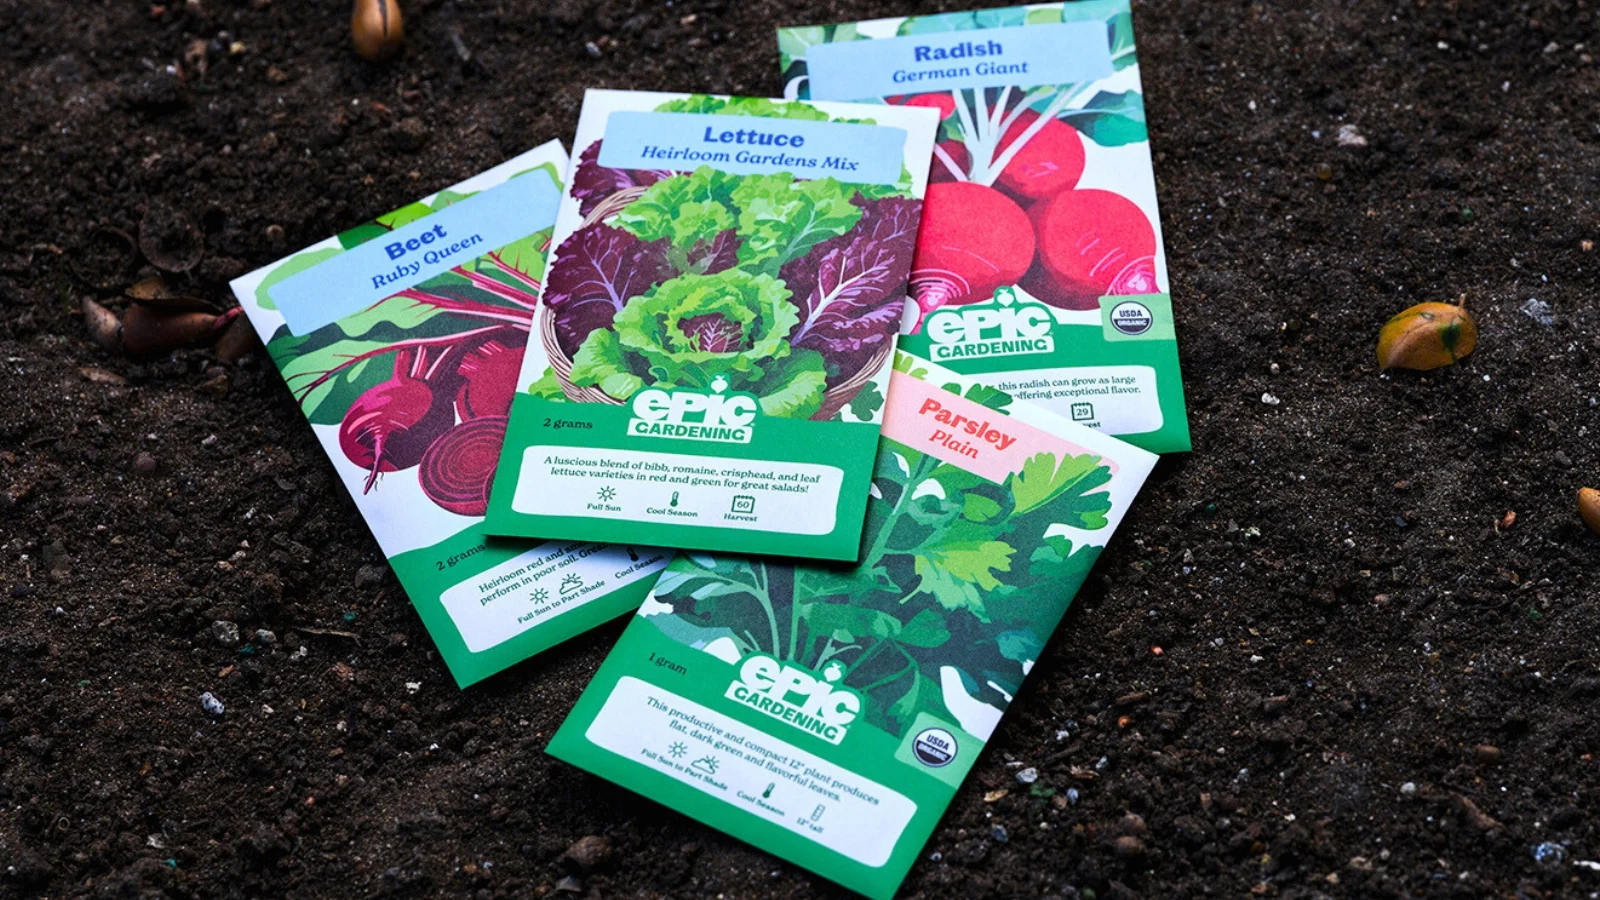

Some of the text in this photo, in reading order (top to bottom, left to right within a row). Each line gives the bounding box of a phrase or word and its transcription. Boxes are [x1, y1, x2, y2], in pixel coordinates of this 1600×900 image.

[914, 40, 1003, 62] Radish
[892, 61, 1029, 84] German Giant
[703, 126, 805, 148] Lettuce
[641, 145, 859, 171] Heirloom Gardens Mix
[384, 224, 448, 261] Beet
[371, 233, 484, 289] Ruby Queen
[936, 338, 1048, 358] GARDENING
[998, 382, 1017, 390] this
[1020, 379, 1050, 389] radish
[1052, 379, 1070, 387] can
[1071, 376, 1097, 387] grow
[1112, 375, 1136, 385] large
[1054, 385, 1110, 398] exceptional
[1111, 385, 1141, 395] flavor.
[543, 418, 593, 430] 2 grams
[918, 398, 1017, 451] Parsley
[1076, 408, 1089, 416] 29
[635, 421, 746, 441] GARDENING
[928, 429, 979, 459] Plain
[544, 456, 821, 484] A luscious blend of bibb, romaine, crisphead, and leaf
[550, 467, 809, 493] lettuce varieties in red and green for great salads!
[604, 504, 622, 512] Sun
[646, 507, 699, 517] Cool Season
[723, 513, 758, 522] Harvest
[737, 501, 750, 509] 60
[436, 543, 486, 571] 2 grams
[615, 554, 665, 579] Cool Season
[478, 568, 526, 593] Heirloom
[526, 557, 544, 571] red
[545, 548, 564, 563] and
[480, 582, 521, 606] perform
[521, 575, 533, 586] in
[533, 564, 557, 581] poor
[558, 552, 579, 567] soil.
[517, 580, 606, 624] Full Sun to Part Shade
[648, 652, 687, 675] 1 gram
[733, 687, 839, 741] GARDENING
[647, 696, 669, 713] This
[668, 707, 724, 736] productive
[724, 731, 745, 745] and
[745, 740, 788, 765] compact
[803, 766, 832, 784] plant
[831, 779, 880, 805] produces
[926, 734, 949, 751] USDA
[641, 748, 728, 791] Full Sun to Part Shade
[669, 719, 841, 802] flat, dark green and flavorful leaves.
[736, 790, 785, 817] Cool Season
